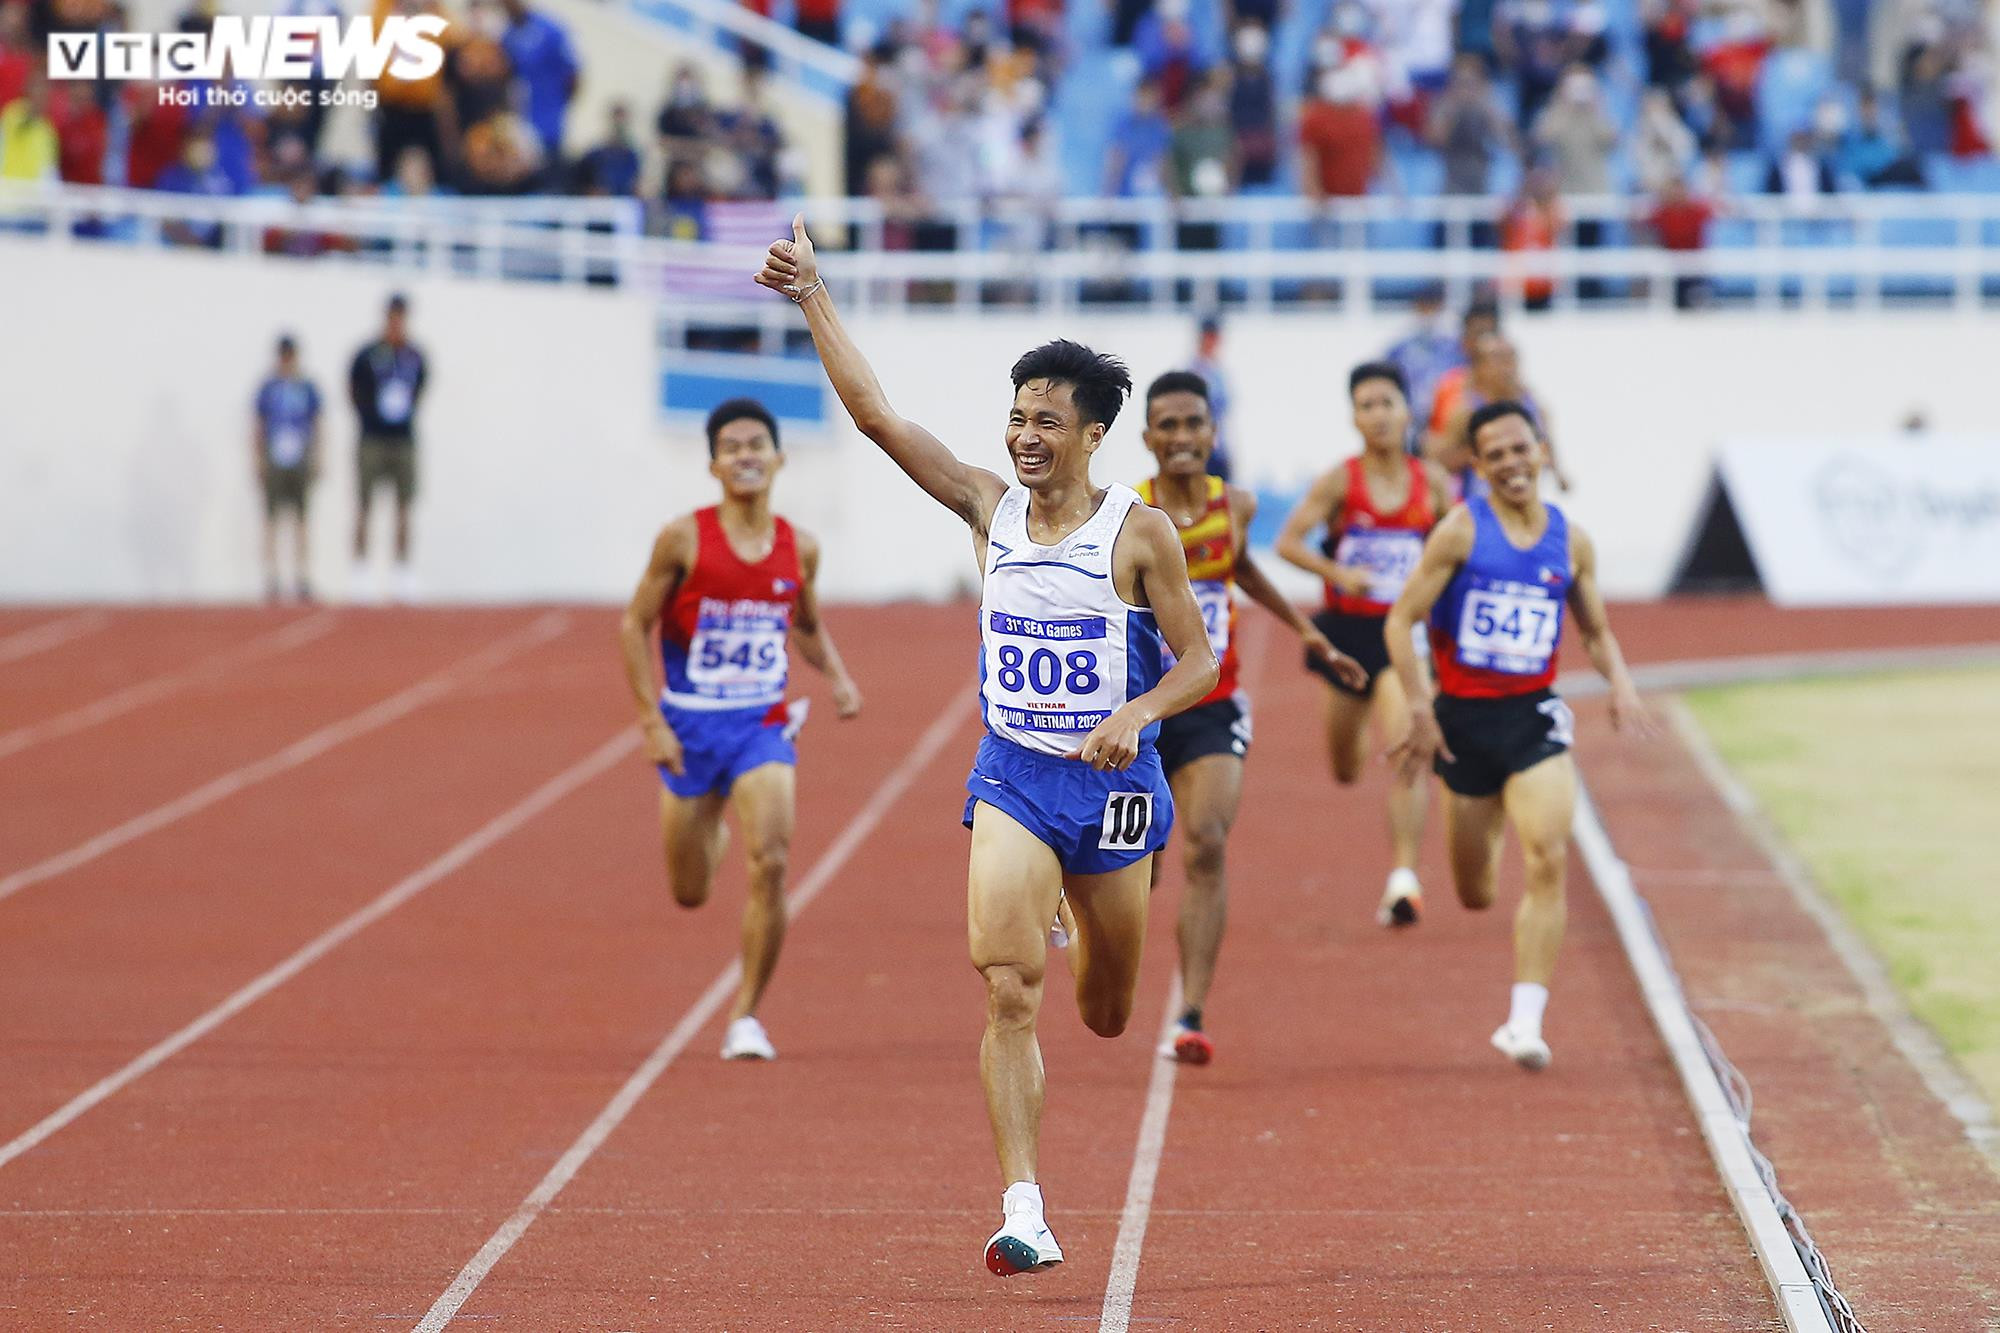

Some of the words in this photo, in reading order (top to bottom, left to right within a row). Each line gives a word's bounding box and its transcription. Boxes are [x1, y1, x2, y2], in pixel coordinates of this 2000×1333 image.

[1024, 620, 1045, 636] SEA
[1046, 623, 1083, 637] Games
[1474, 601, 1547, 645] 547
[702, 639, 776, 671] 549
[998, 645, 1100, 695] 808
[1032, 713, 1075, 729] VIETNAM
[1109, 796, 1147, 845] 10
